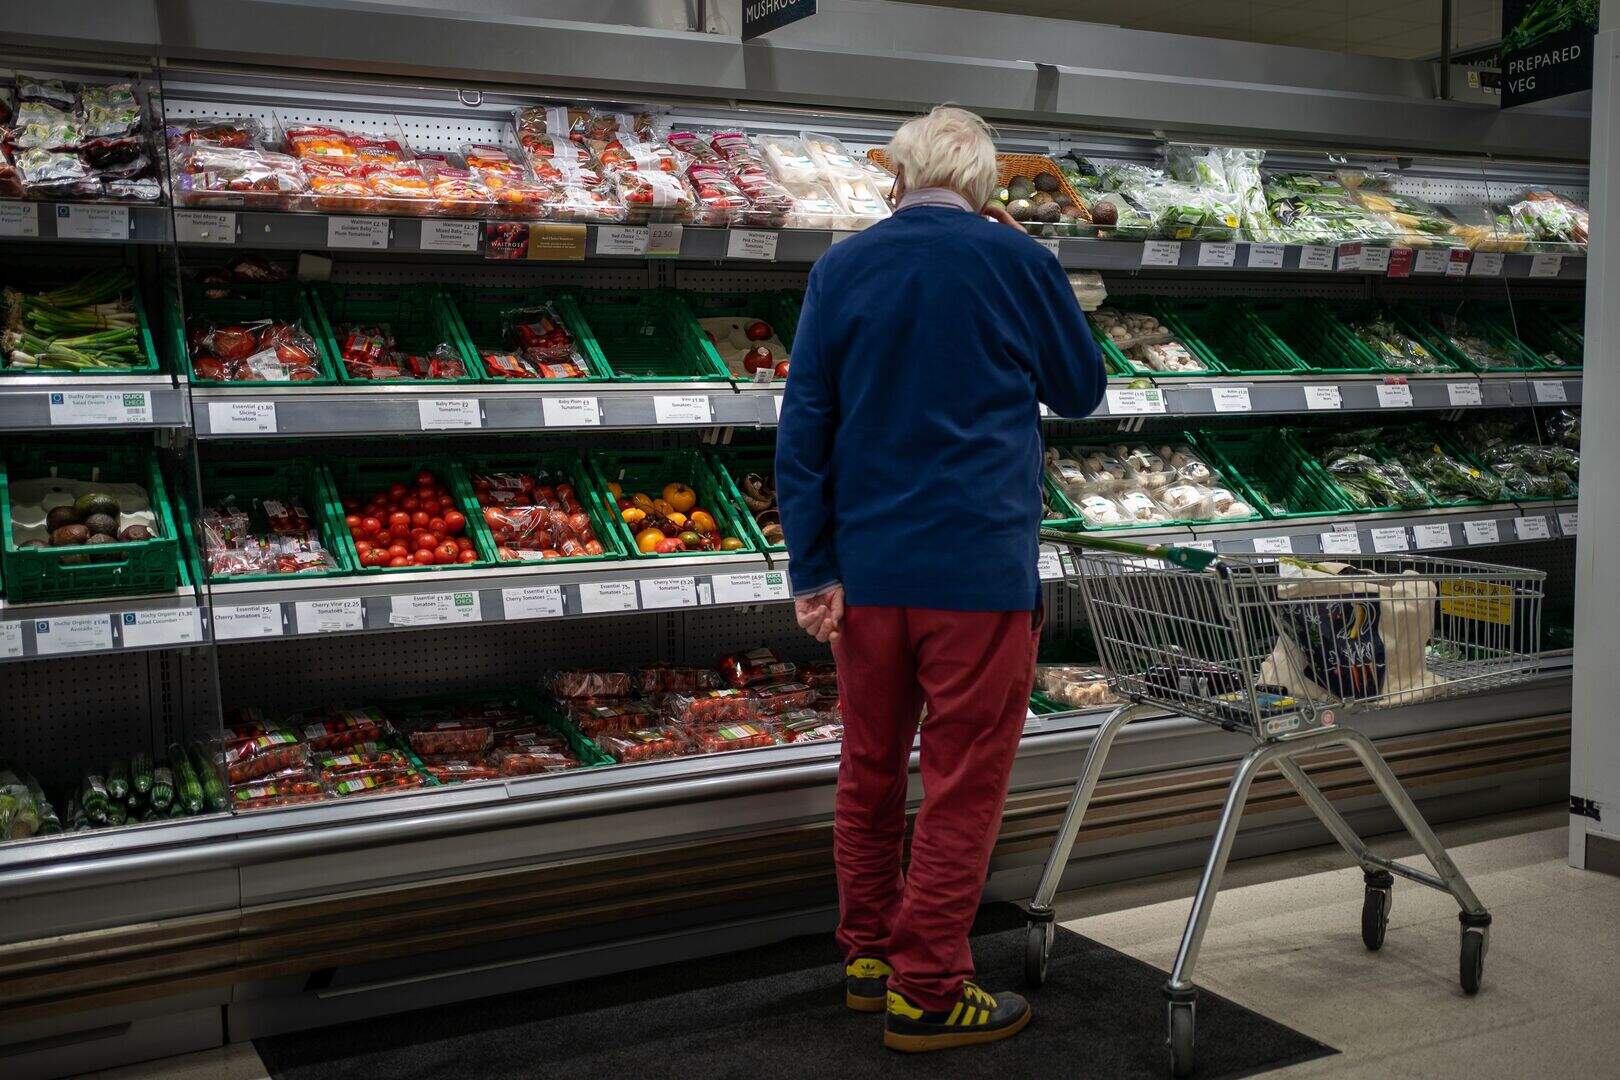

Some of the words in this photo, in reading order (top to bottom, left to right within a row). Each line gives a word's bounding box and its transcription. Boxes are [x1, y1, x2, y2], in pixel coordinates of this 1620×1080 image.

[1509, 45, 1581, 75] PREPARED
[1508, 76, 1536, 94] VEG
[23, 205, 31, 213] £2
[652, 230, 673, 238] £2.50
